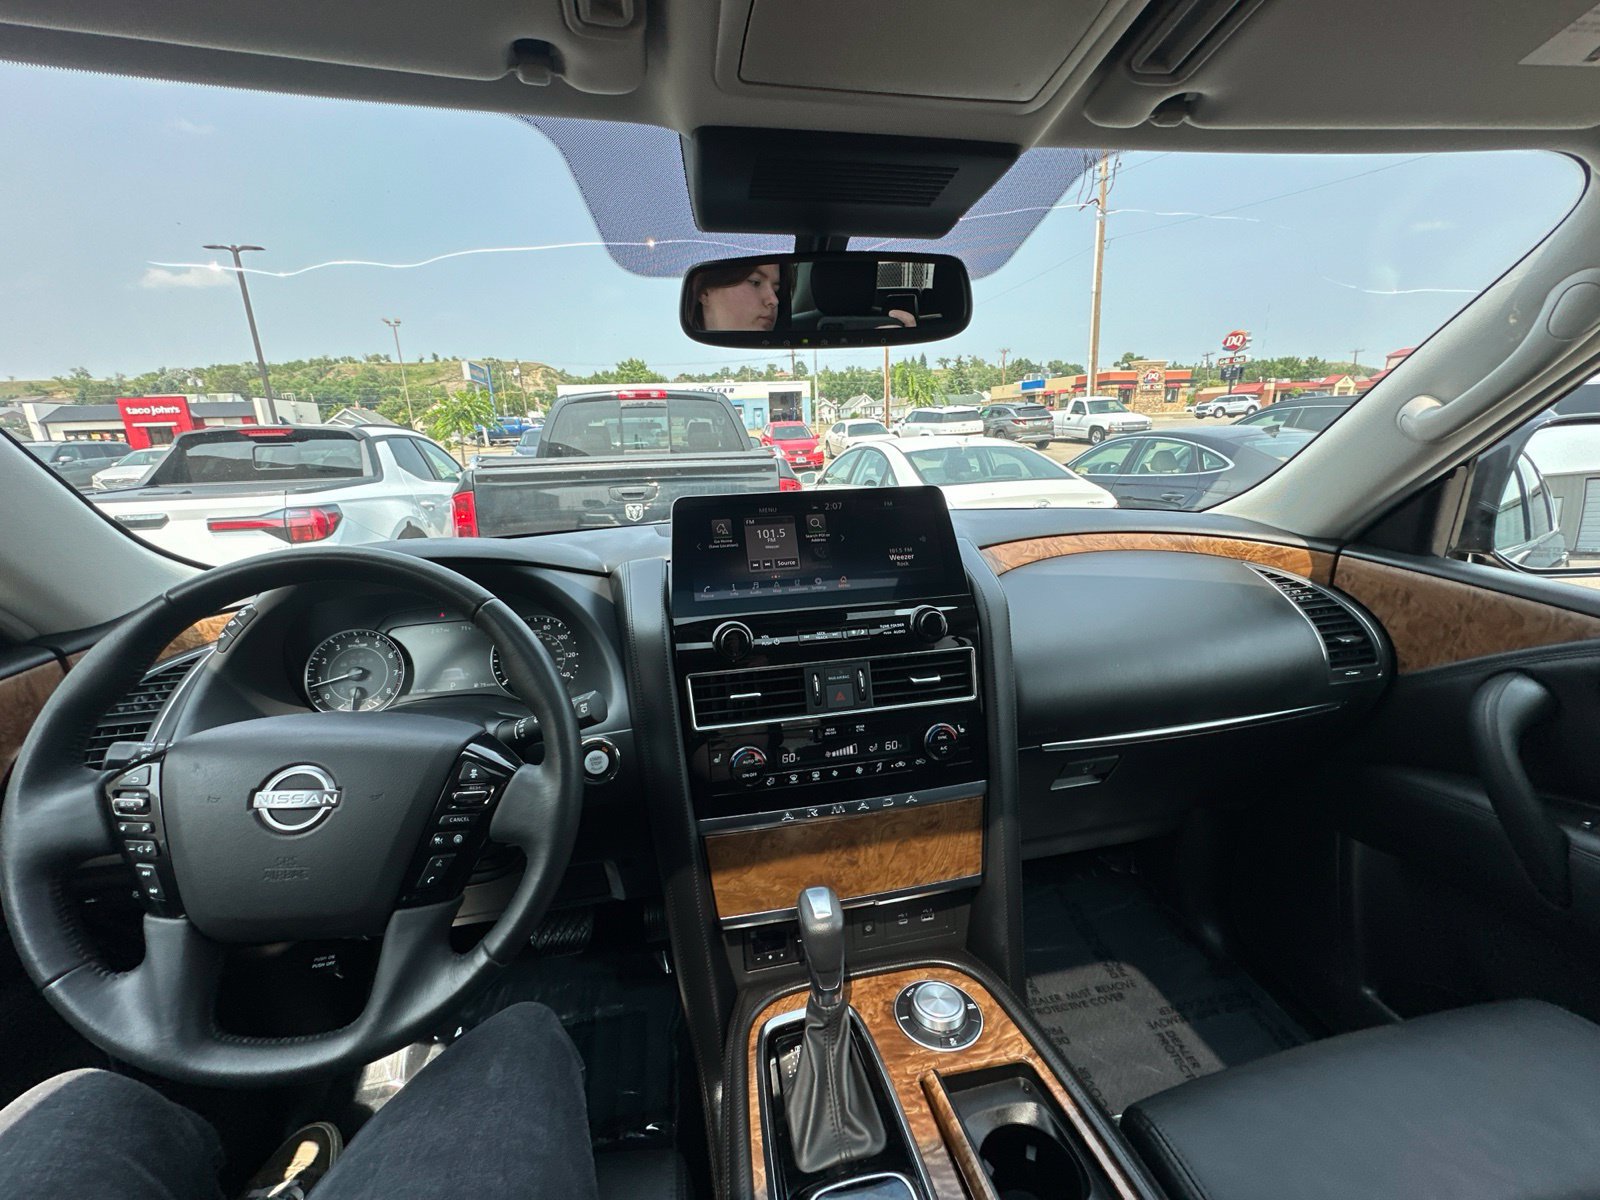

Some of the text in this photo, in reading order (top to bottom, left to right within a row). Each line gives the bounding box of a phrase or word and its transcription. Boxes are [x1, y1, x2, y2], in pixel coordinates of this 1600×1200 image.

[1226, 334, 1244, 347] DQ
[125, 407, 150, 415] taco
[825, 502, 842, 511] 2:07
[757, 528, 786, 539] 101.5
[889, 553, 915, 561] Weezer
[256, 793, 338, 806] NISSAN
[1066, 987, 1092, 1001] MUST
[1094, 979, 1137, 993] REMOVE
[1090, 991, 1125, 1008] COVER
